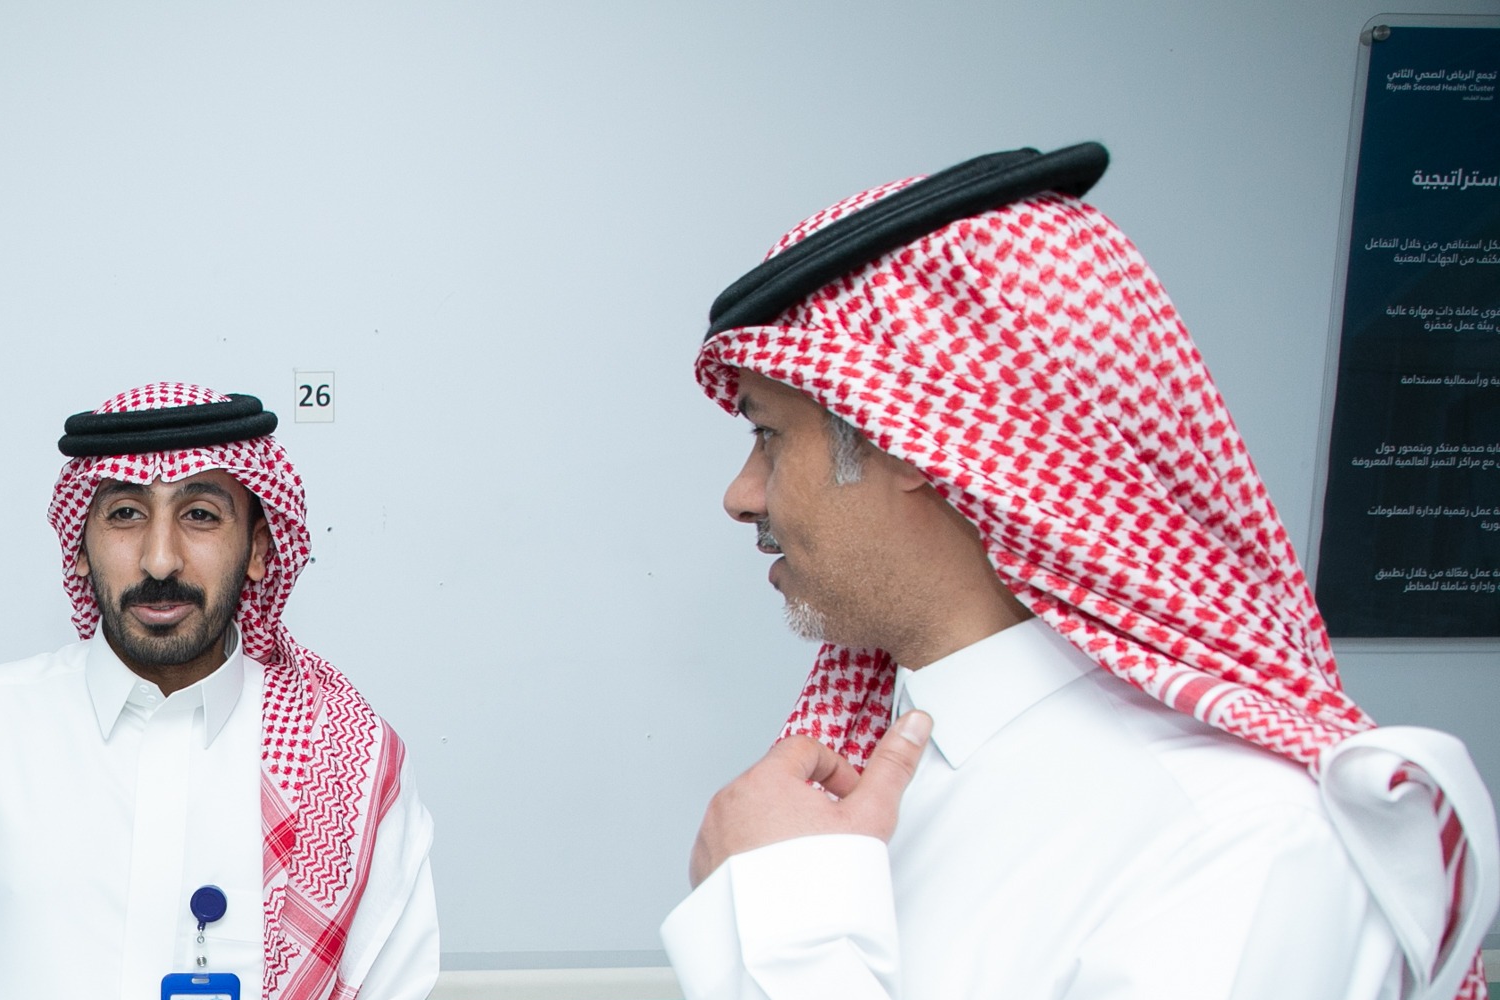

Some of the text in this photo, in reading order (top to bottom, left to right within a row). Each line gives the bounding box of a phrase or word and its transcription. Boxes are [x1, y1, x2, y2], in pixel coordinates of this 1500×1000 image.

[1386, 82, 1495, 92] Riyadh Second Health Cluster
[299, 384, 331, 407] 26
